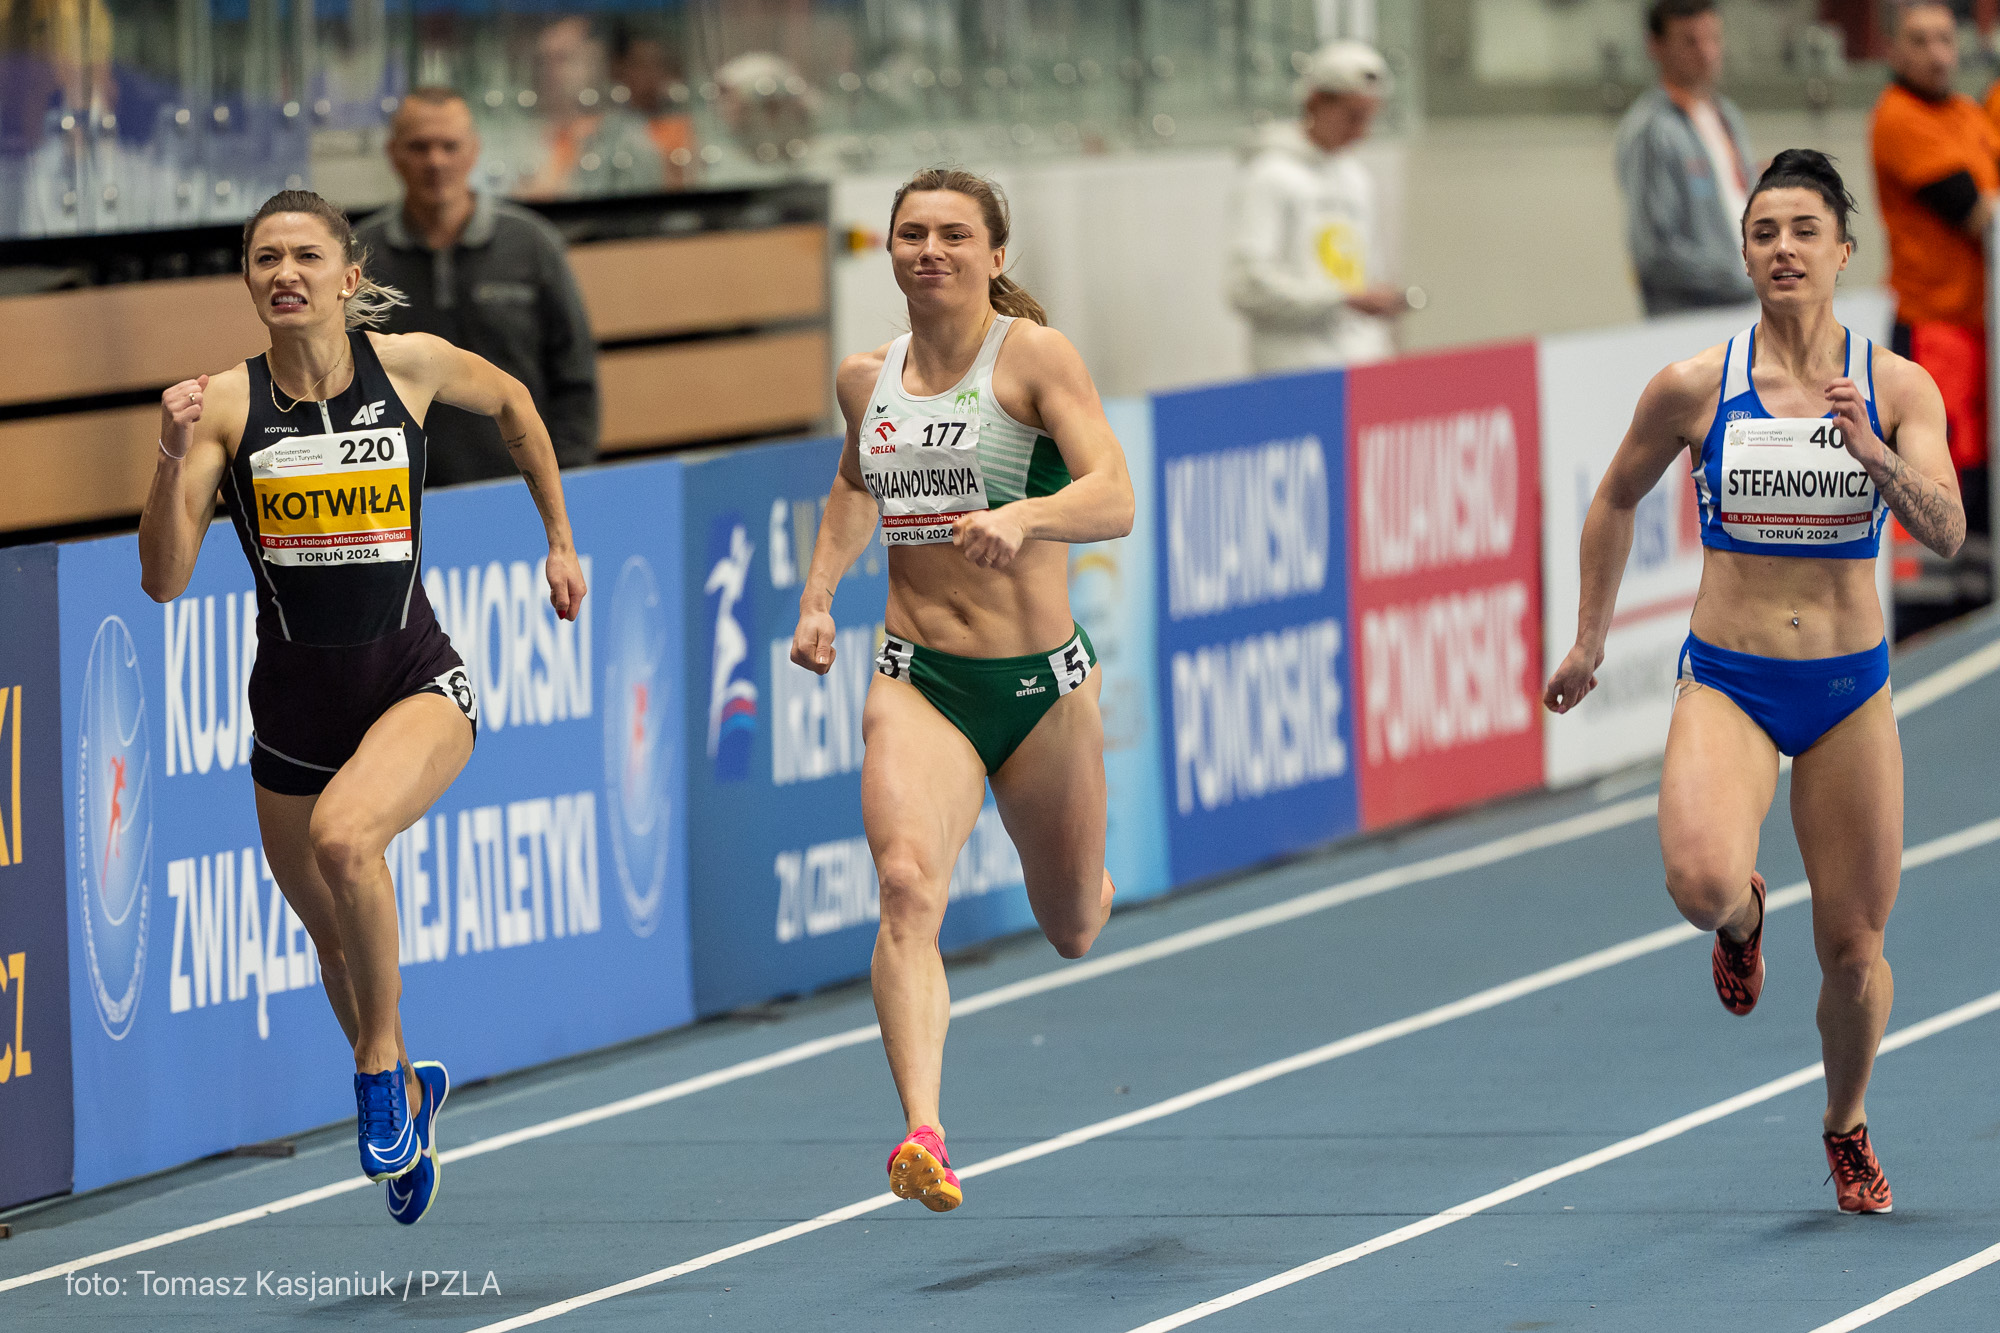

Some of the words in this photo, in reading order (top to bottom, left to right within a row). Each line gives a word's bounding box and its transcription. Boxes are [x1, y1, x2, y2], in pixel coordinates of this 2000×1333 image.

[264, 426, 300, 434] KOTWIŁA
[922, 422, 967, 447] 177
[1809, 426, 1844, 449] 40
[274, 448, 311, 456] Ministerstwo
[339, 436, 395, 465] 220
[870, 444, 896, 455] ORLEN
[297, 453, 323, 462] Turystyki
[1728, 469, 1869, 498] STEFANOWICZ
[262, 484, 405, 521] KOTWIŁA
[888, 517, 914, 526] Halowe
[915, 514, 959, 525] Mistrzostwa
[1727, 514, 1741, 522] 68.
[1742, 515, 1762, 523] PZLA
[1763, 515, 1795, 524] Halowe
[1796, 516, 1845, 525] Mistrzostwa
[265, 537, 278, 547] 68.
[279, 538, 300, 547] PZLA
[300, 537, 332, 546] Halowe
[333, 534, 384, 545] Mistrzostwa
[384, 531, 406, 540] Polski
[886, 528, 924, 542] TORUŃ
[926, 528, 954, 540] 2024
[1757, 527, 1804, 540] TORUŃ
[1806, 530, 1839, 540] 2024
[296, 548, 344, 563] TORUŃ
[346, 548, 380, 560] 2024
[879, 640, 903, 679] 5
[1063, 645, 1087, 690] 5
[447, 670, 472, 714] 6
[1015, 685, 1046, 697] erima
[457, 790, 601, 956] ATLETYKI
